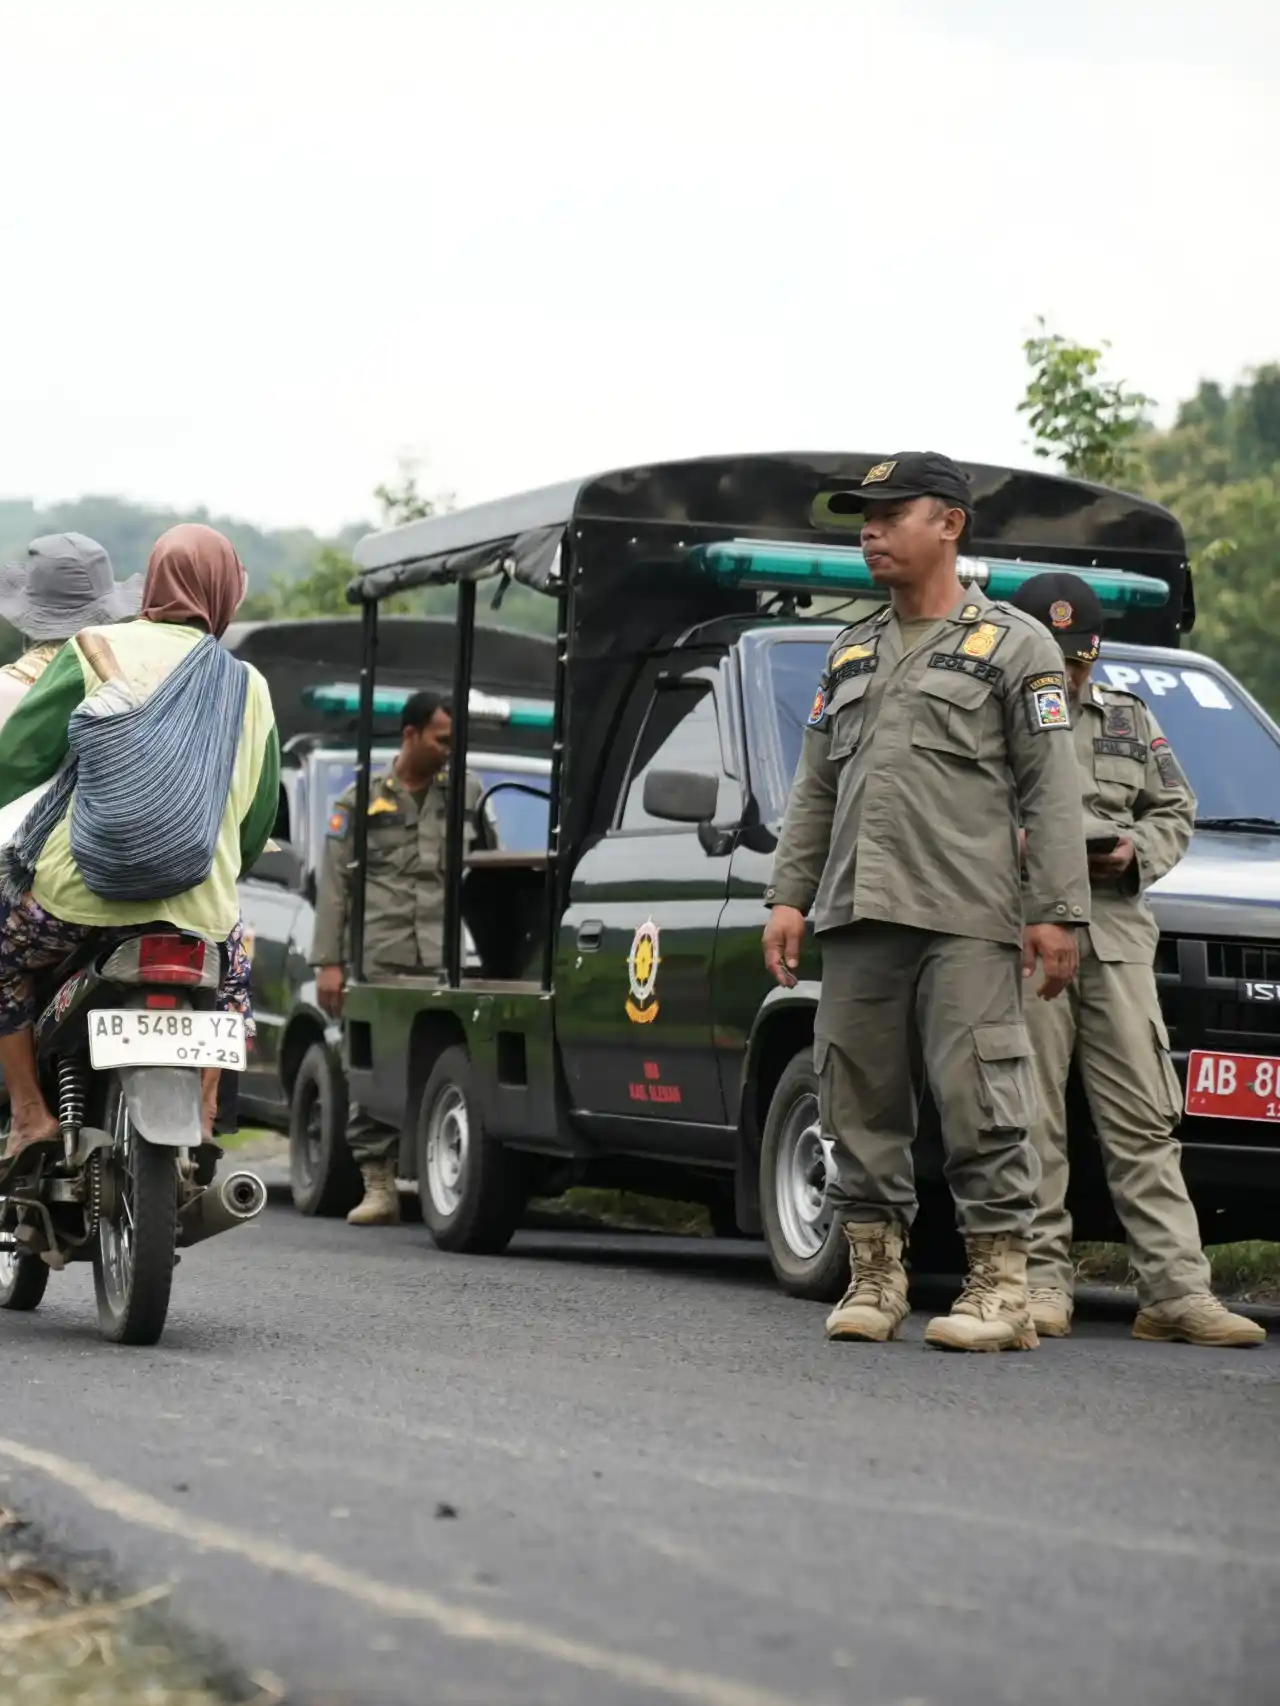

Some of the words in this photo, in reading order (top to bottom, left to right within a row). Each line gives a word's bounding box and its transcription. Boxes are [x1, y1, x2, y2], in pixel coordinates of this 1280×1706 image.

[932, 655, 966, 671] POL
[973, 662, 998, 680] PP
[95, 1015, 124, 1037] AB
[137, 1014, 193, 1037] 5488
[210, 1017, 238, 1038] YZ
[1195, 1057, 1237, 1095] AB
[1254, 1061, 1280, 1099] 8
[1266, 1102, 1280, 1118] 1
